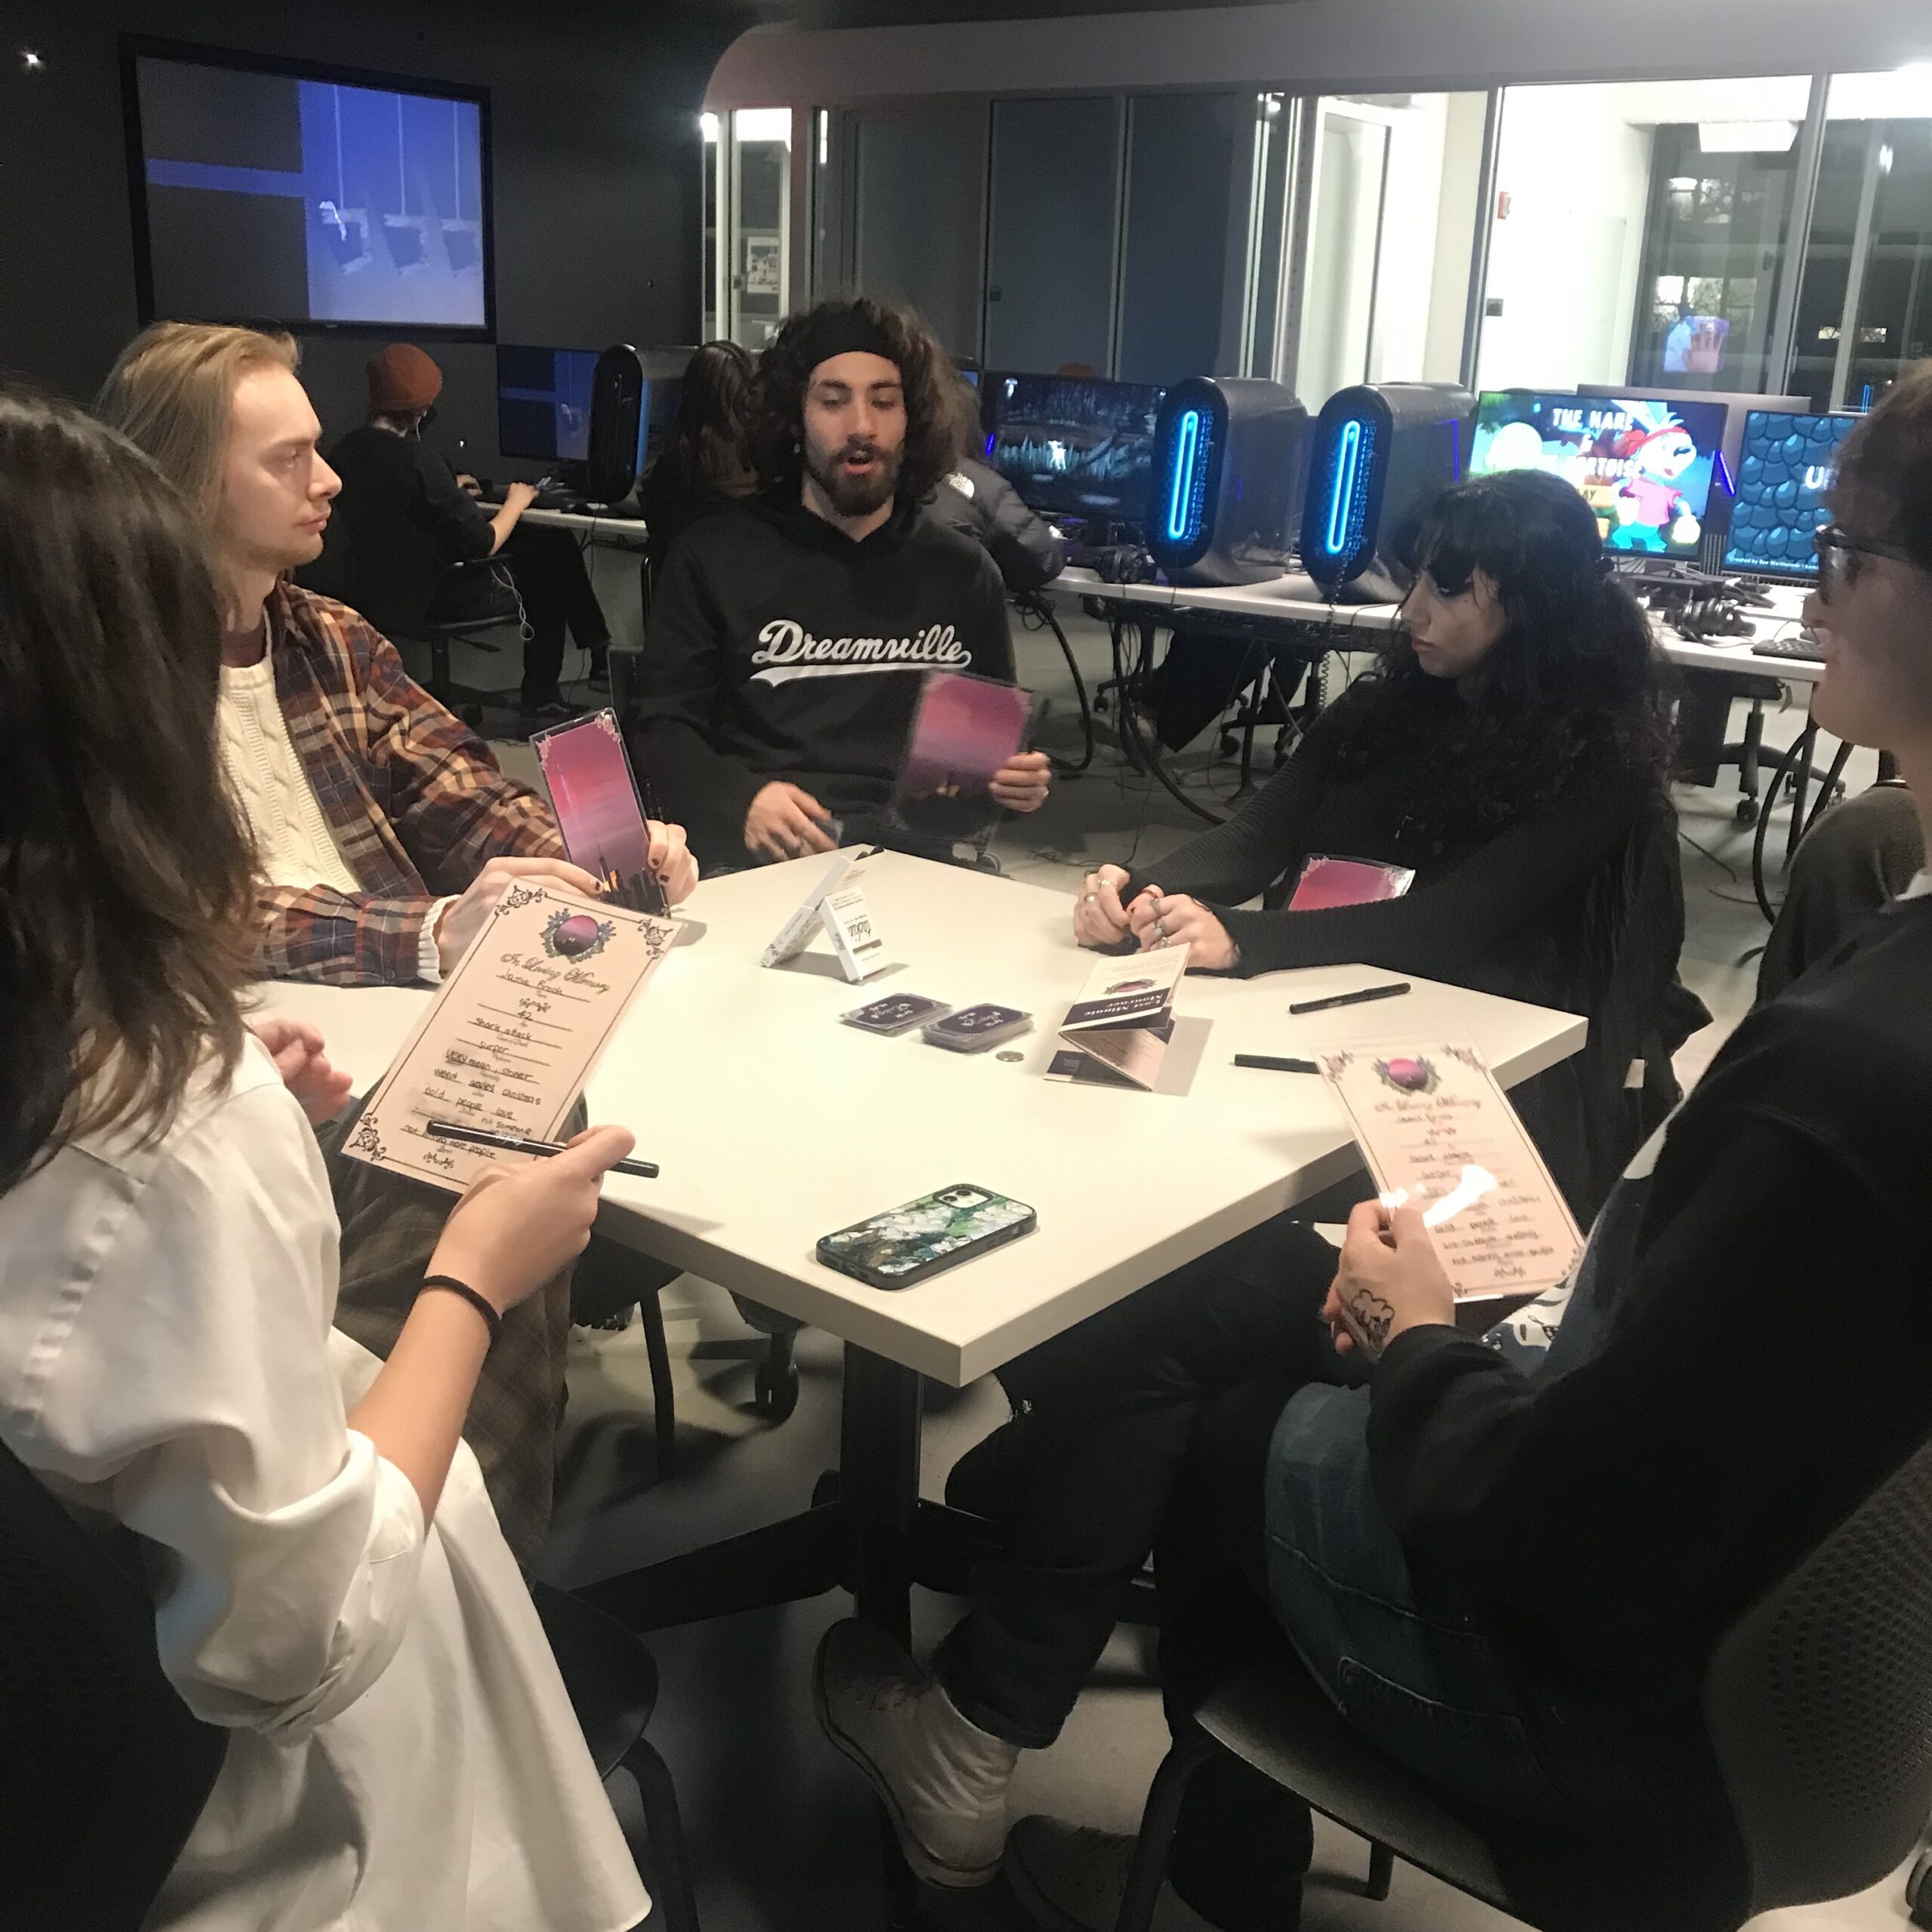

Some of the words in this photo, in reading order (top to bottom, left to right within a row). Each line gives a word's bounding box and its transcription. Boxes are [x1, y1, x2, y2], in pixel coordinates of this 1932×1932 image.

[1553, 408, 1583, 429] THE
[1589, 411, 1634, 431] HARE
[751, 619, 971, 666] Dreamville
[500, 953, 524, 966] In
[521, 957, 561, 981] Loving
[564, 968, 610, 995] Memory
[1106, 993, 1163, 1008] Mourner
[518, 1010, 533, 1020] 42
[1084, 1005, 1129, 1017] Minute
[504, 1029, 532, 1041] attack
[502, 1067, 533, 1081] stoner
